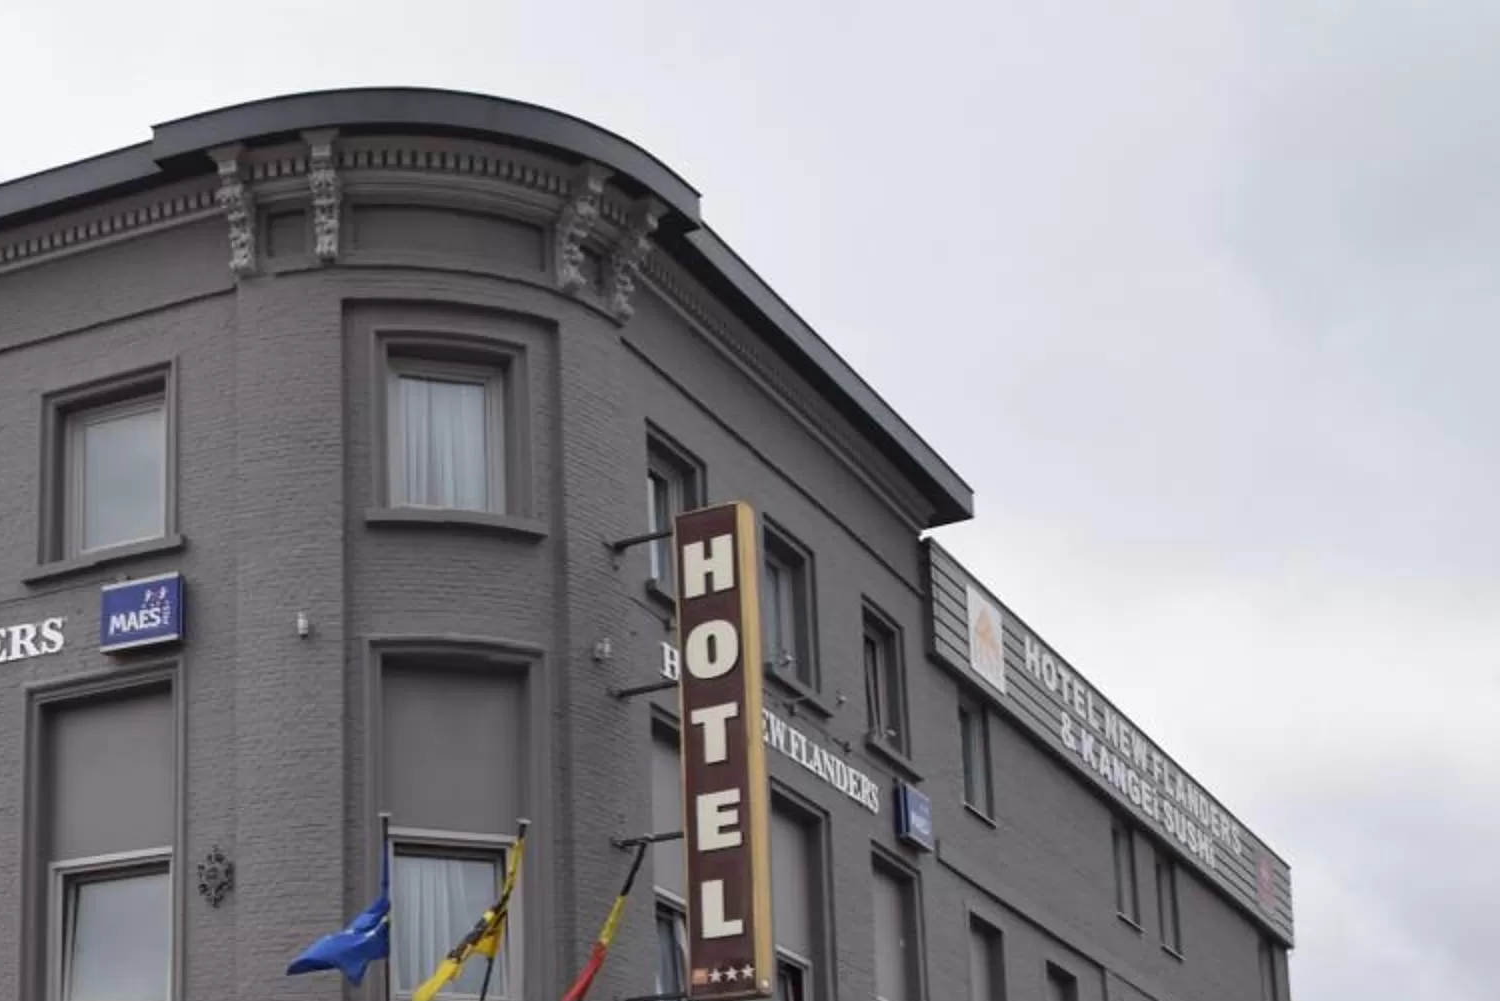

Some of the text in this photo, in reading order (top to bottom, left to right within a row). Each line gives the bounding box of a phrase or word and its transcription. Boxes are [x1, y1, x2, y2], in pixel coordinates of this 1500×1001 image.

[108, 607, 161, 636] MAES
[683, 533, 744, 939] HOTEL
[788, 726, 880, 815] FLANDERS
[1024, 635, 1242, 855] HOTEL NEW FLANDERS
[1061, 711, 1077, 750] &
